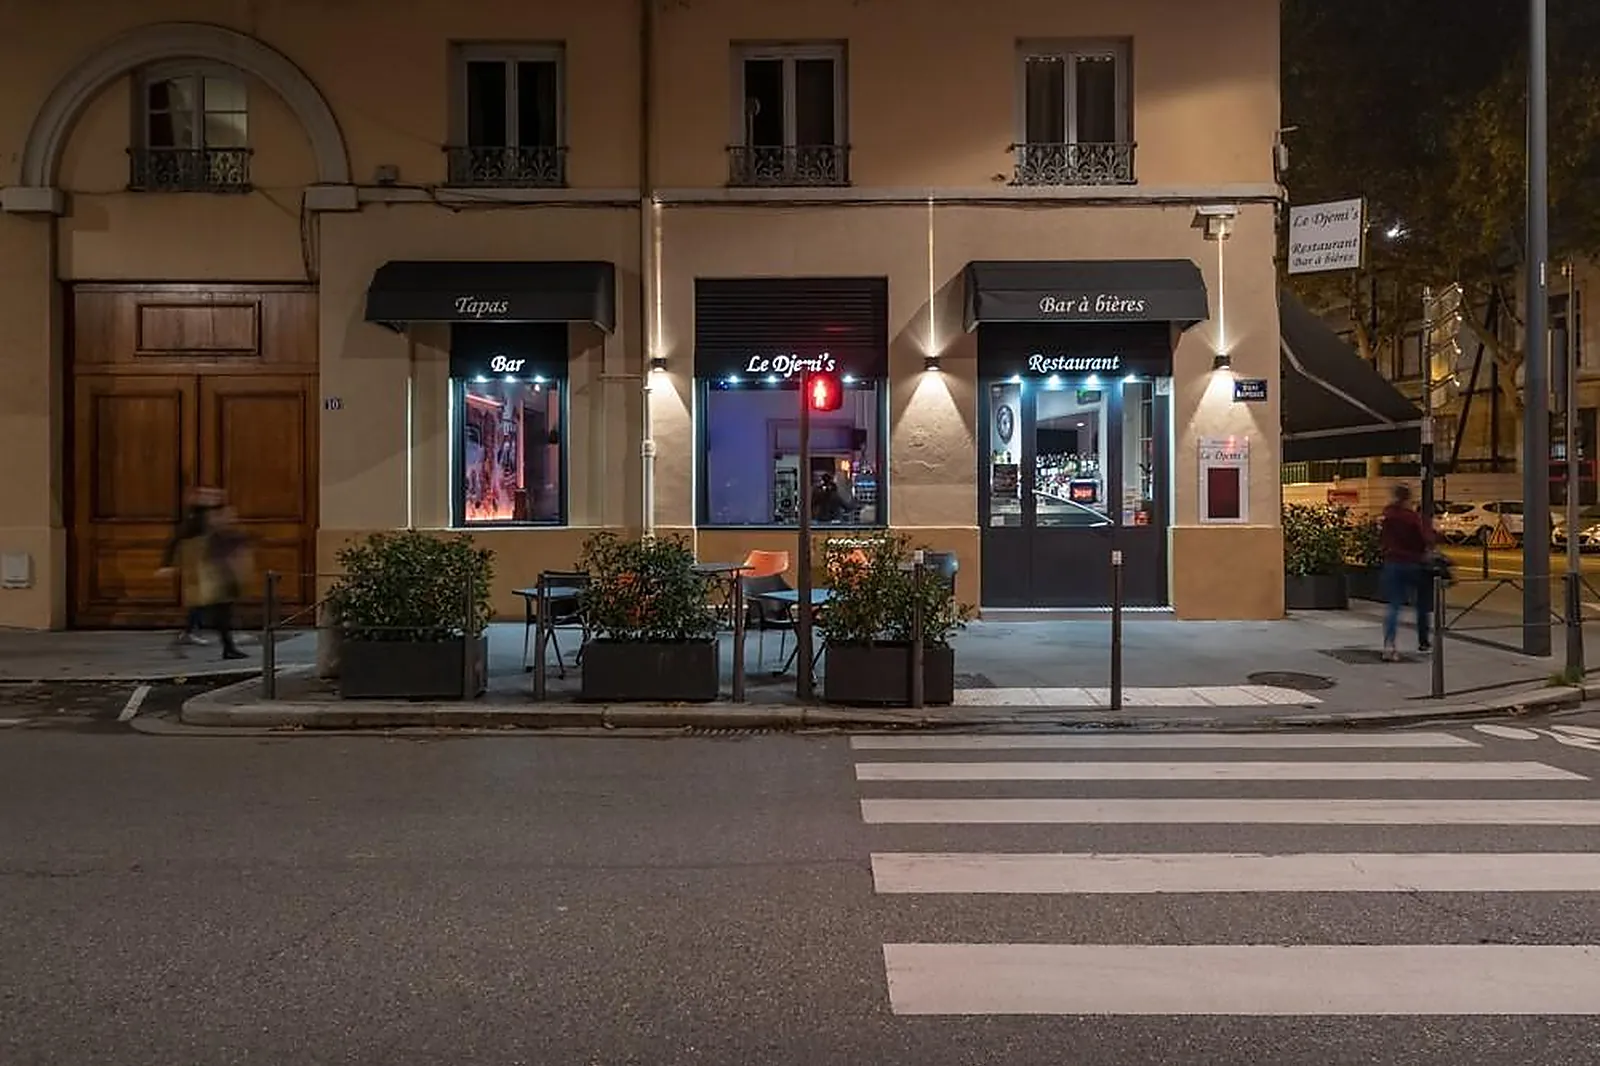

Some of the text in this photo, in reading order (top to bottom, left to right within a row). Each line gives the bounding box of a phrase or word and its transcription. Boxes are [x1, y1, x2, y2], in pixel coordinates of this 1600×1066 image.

[1293, 207, 1359, 228] Le Djemi's
[1292, 237, 1357, 254] Restaurant
[1292, 256, 1312, 267] Bar
[455, 296, 508, 317] Tapas
[1039, 294, 1145, 313] Bar à bières
[491, 355, 525, 373] Bar
[746, 352, 836, 378] Le Djemi's
[1028, 354, 1120, 373] Restaurant
[327, 398, 338, 411] 10
